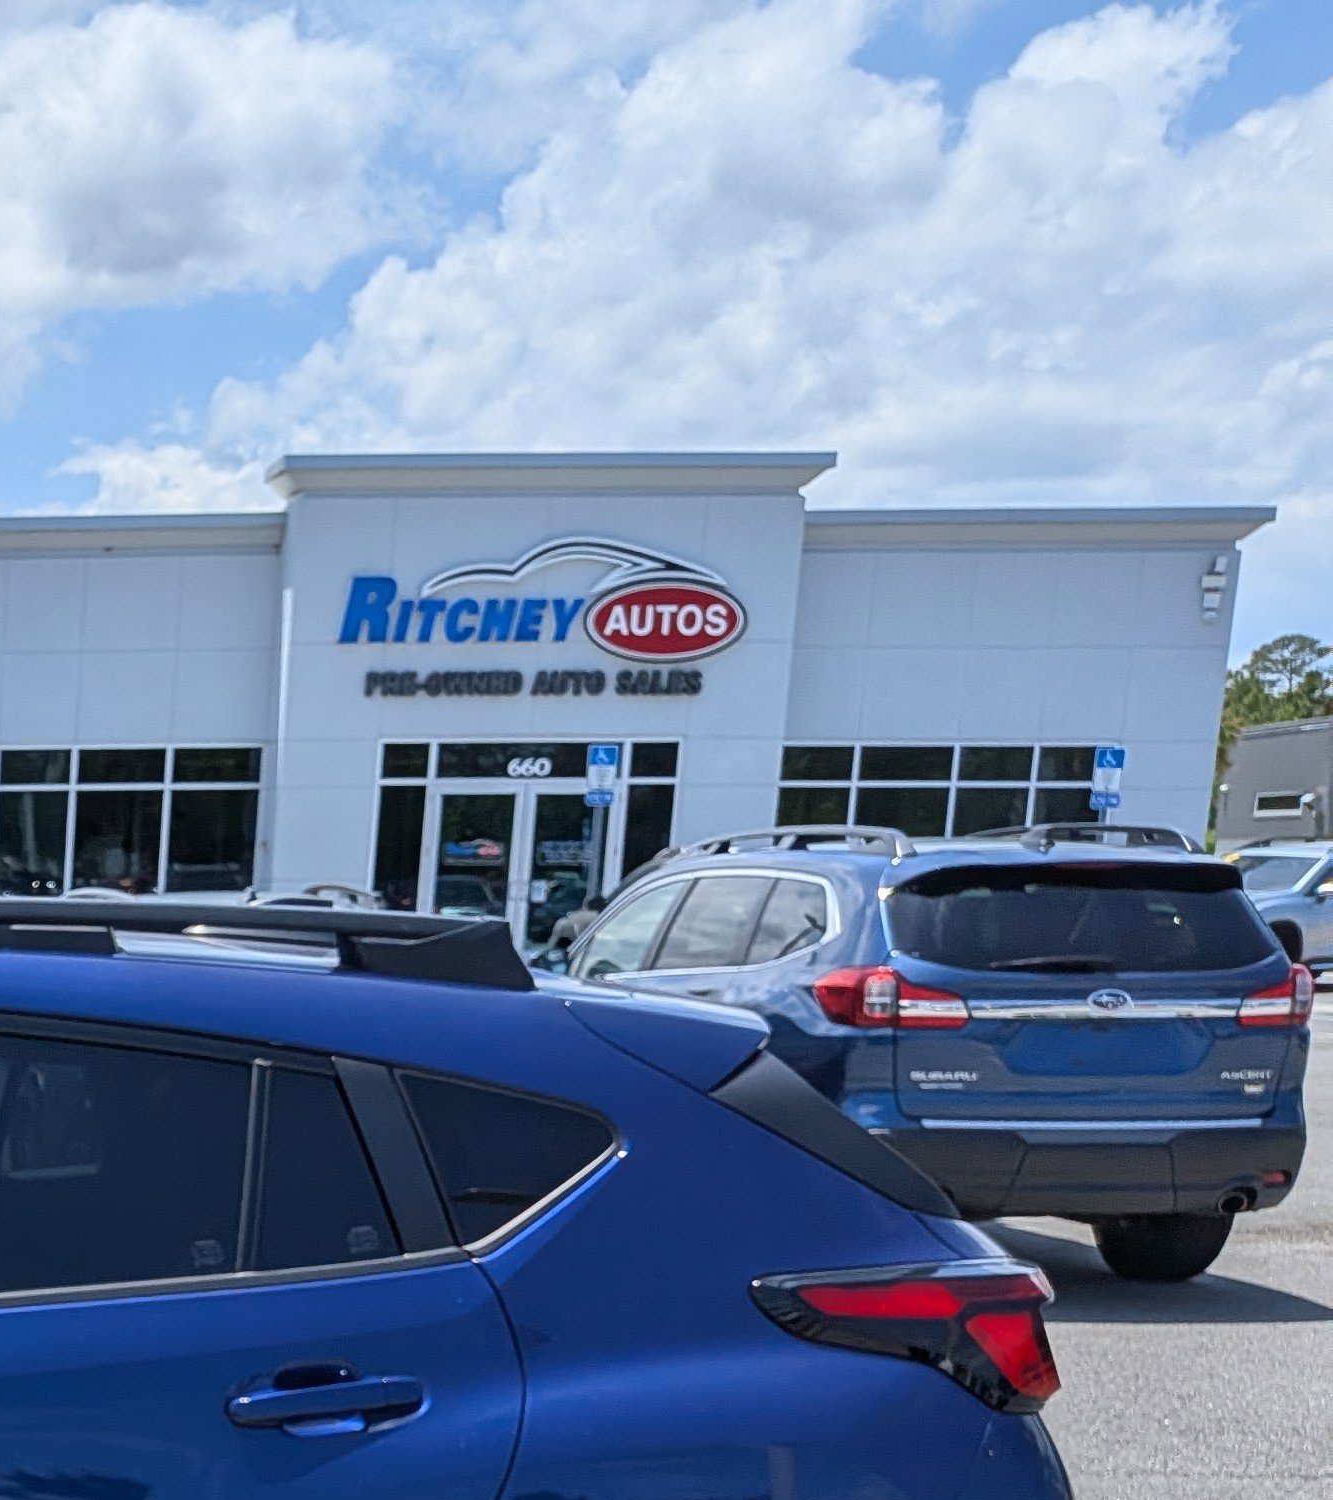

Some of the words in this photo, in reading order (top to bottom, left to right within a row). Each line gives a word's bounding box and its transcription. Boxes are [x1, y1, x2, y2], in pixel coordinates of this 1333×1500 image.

[337, 575, 585, 643] RITCHEY
[603, 604, 728, 637] AUTOS
[364, 670, 523, 697] PRE-OWNED
[530, 669, 606, 697] AUTO
[614, 669, 703, 696] SALES
[506, 756, 552, 777] 660
